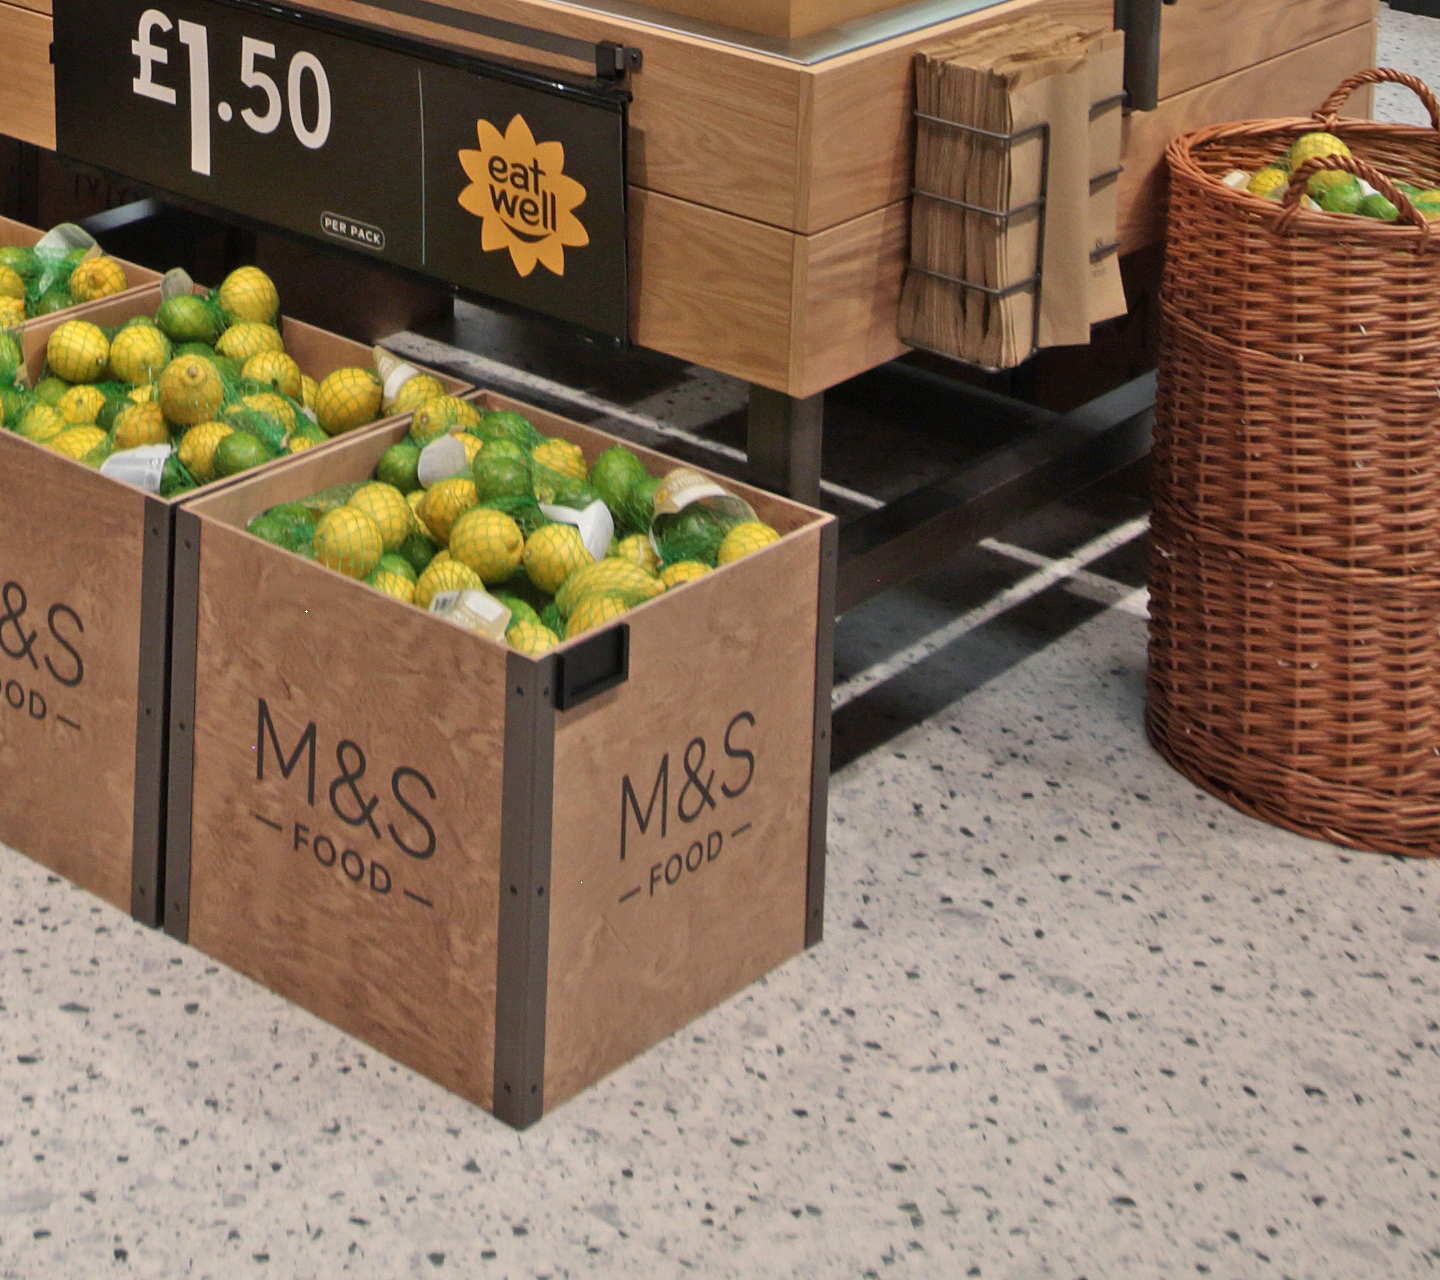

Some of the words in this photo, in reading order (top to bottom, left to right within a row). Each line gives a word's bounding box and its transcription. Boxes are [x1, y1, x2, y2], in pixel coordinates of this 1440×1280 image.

[130, 7, 332, 177] £1.50
[486, 154, 546, 196] eat
[488, 184, 557, 232] well
[324, 216, 348, 234] PER
[350, 222, 382, 246] PACK
[255, 696, 438, 860] M&S
[619, 709, 757, 861] M&S
[293, 822, 392, 895] FOOD
[648, 829, 724, 897] FOOD
